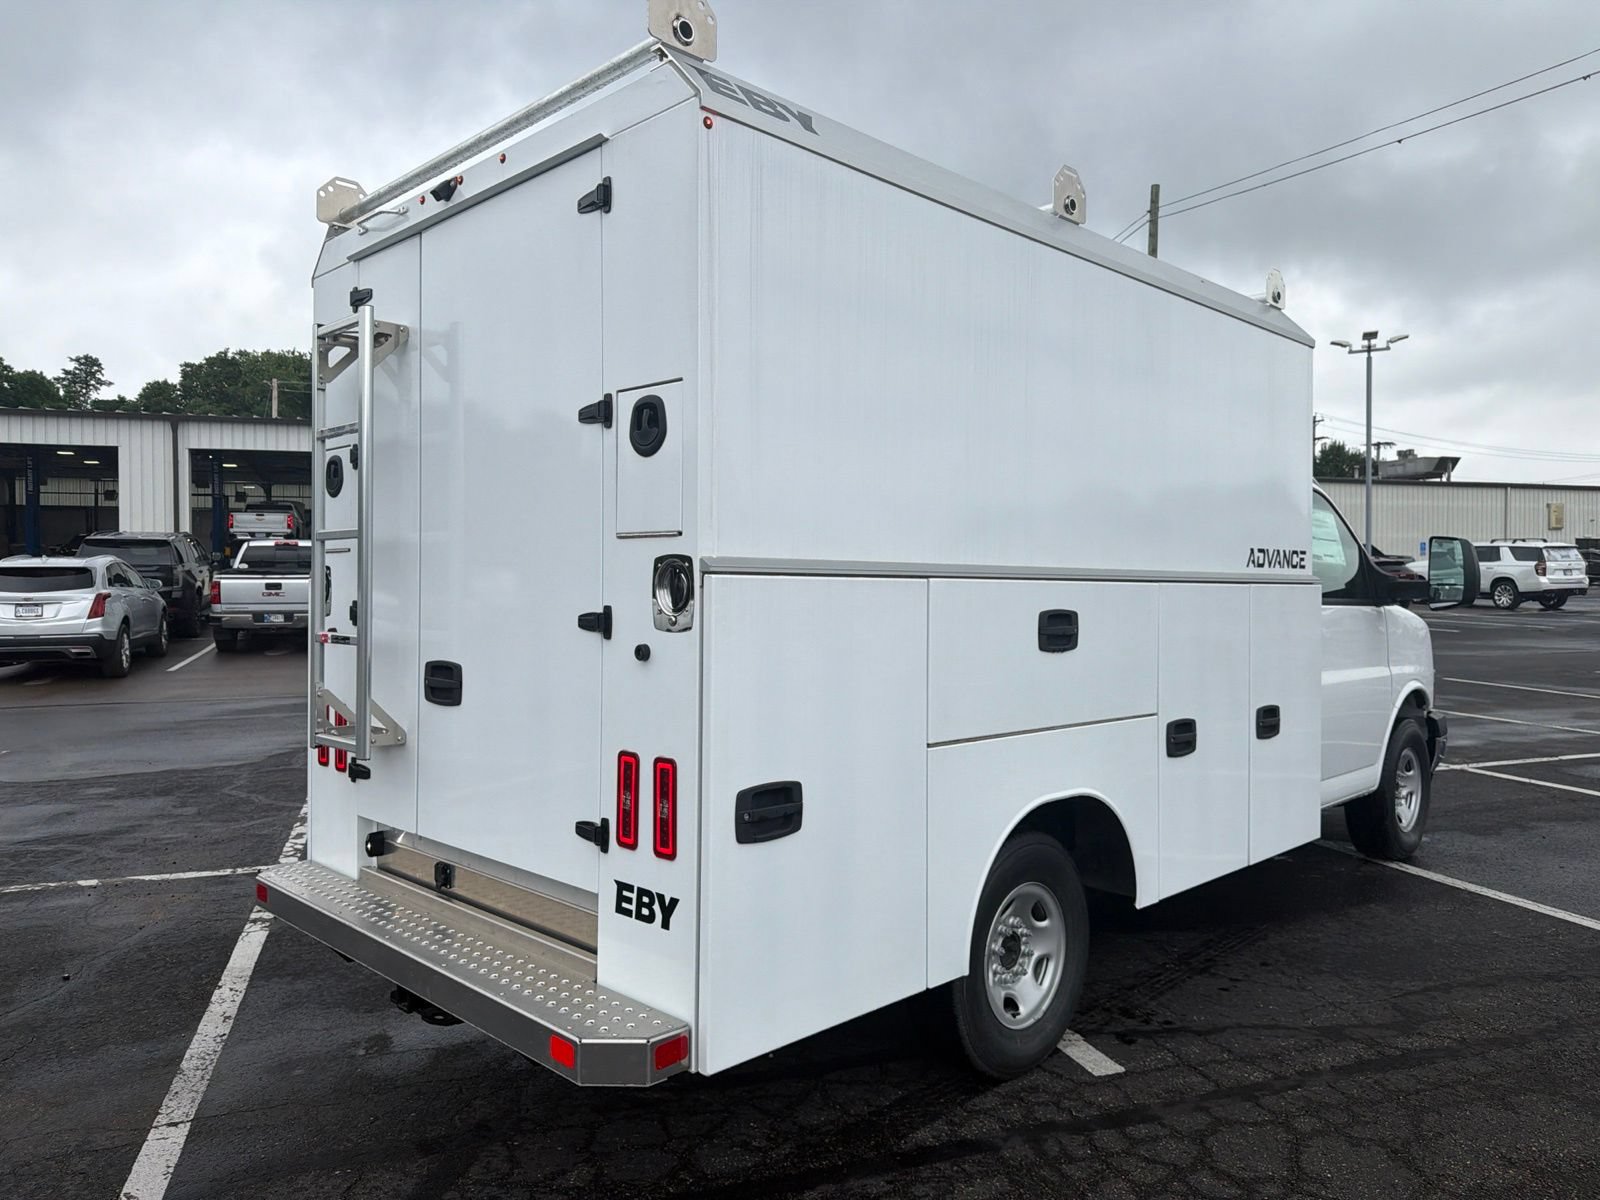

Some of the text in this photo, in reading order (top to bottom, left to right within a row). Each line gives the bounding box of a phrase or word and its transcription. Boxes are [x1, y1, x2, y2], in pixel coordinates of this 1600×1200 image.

[686, 62, 820, 136] EBY
[1246, 547, 1307, 569] ADVANCE
[613, 879, 680, 931] EBY
